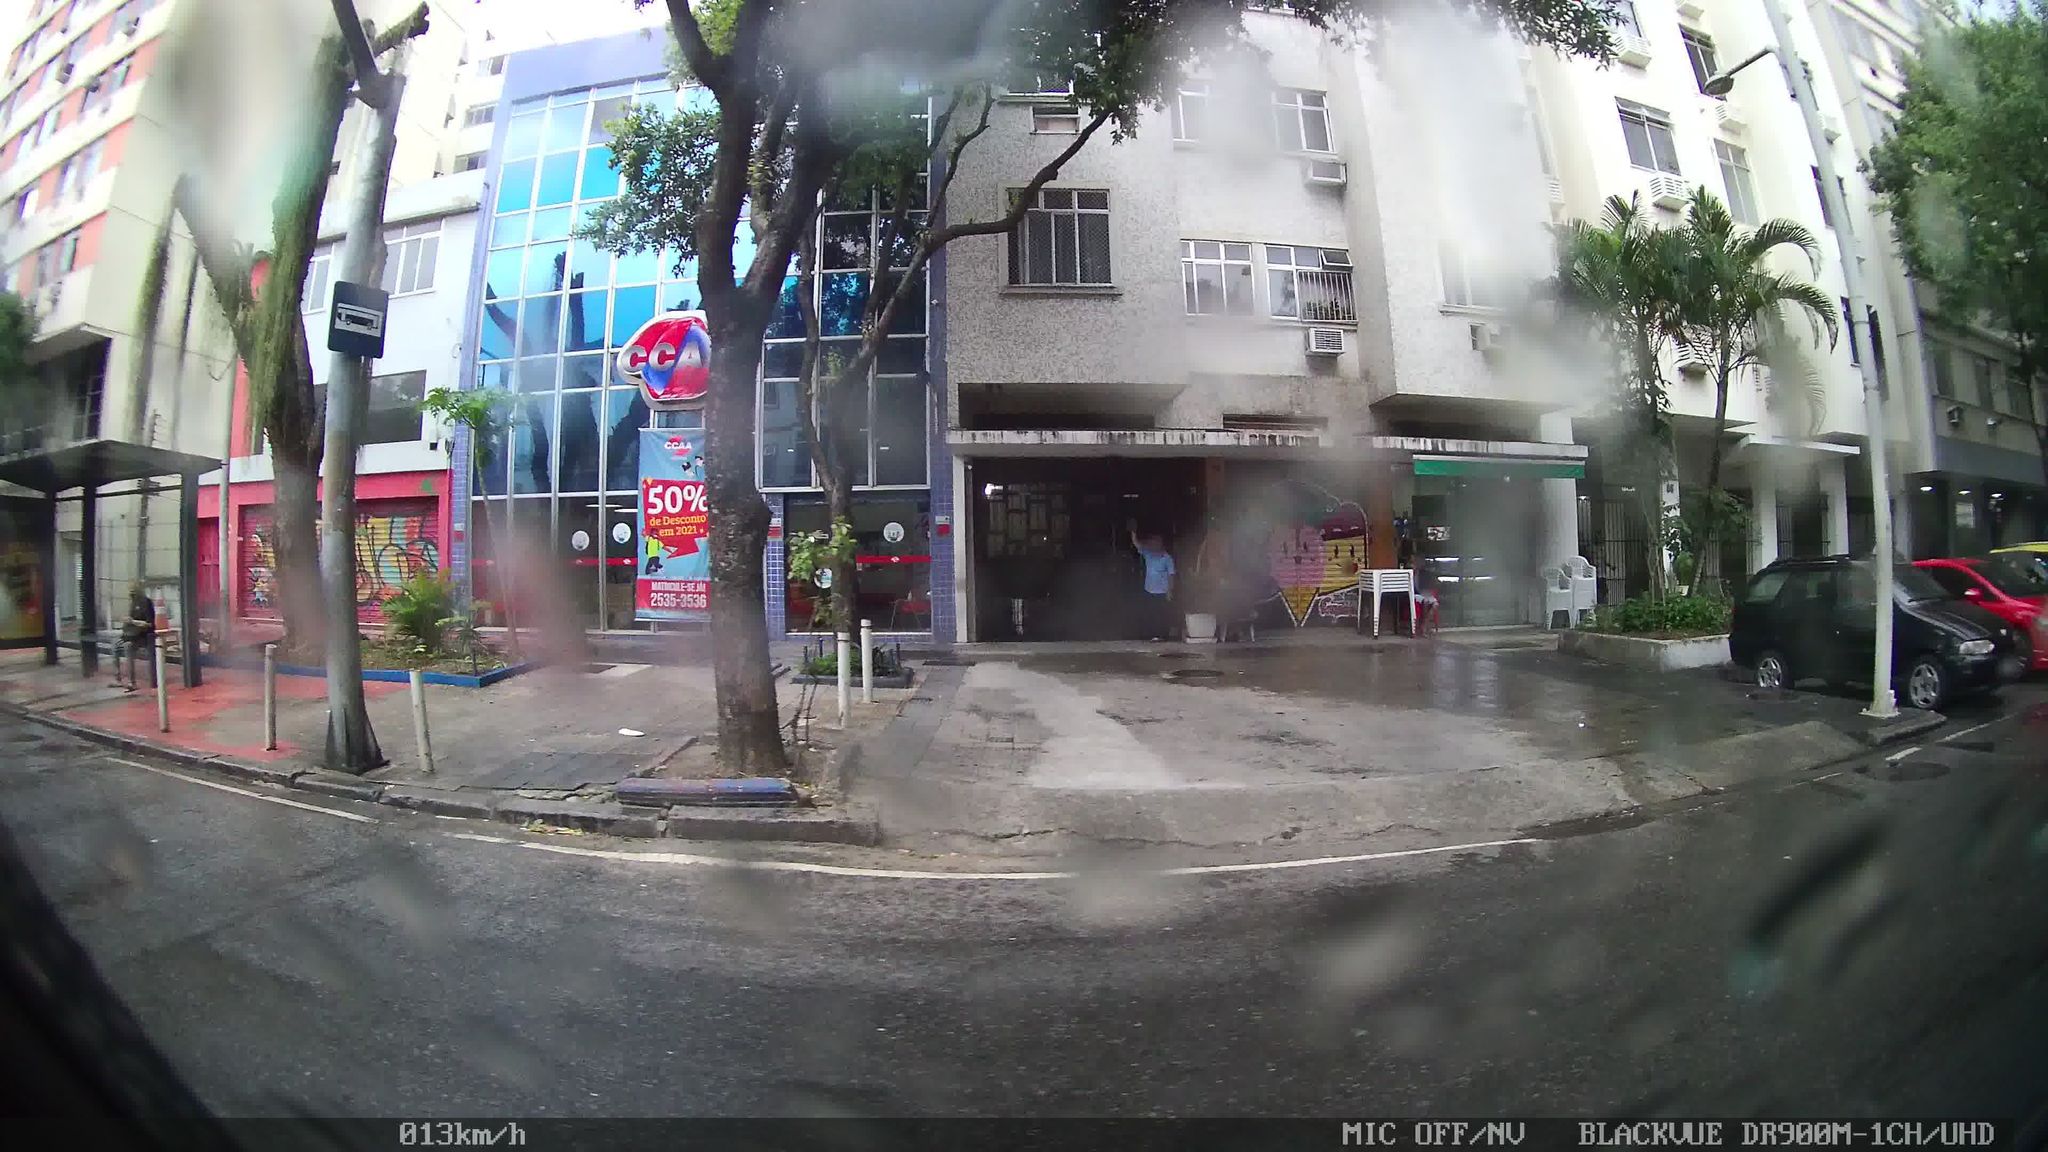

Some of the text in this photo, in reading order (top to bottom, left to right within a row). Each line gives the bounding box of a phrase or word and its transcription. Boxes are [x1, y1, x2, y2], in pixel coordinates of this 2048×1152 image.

[622, 343, 704, 371] CCA
[664, 441, 692, 450] CCAA
[647, 484, 708, 514] 50%
[650, 515, 706, 526] de Desconto
[676, 526, 697, 535] 2021
[650, 593, 706, 607] 2535-3536
